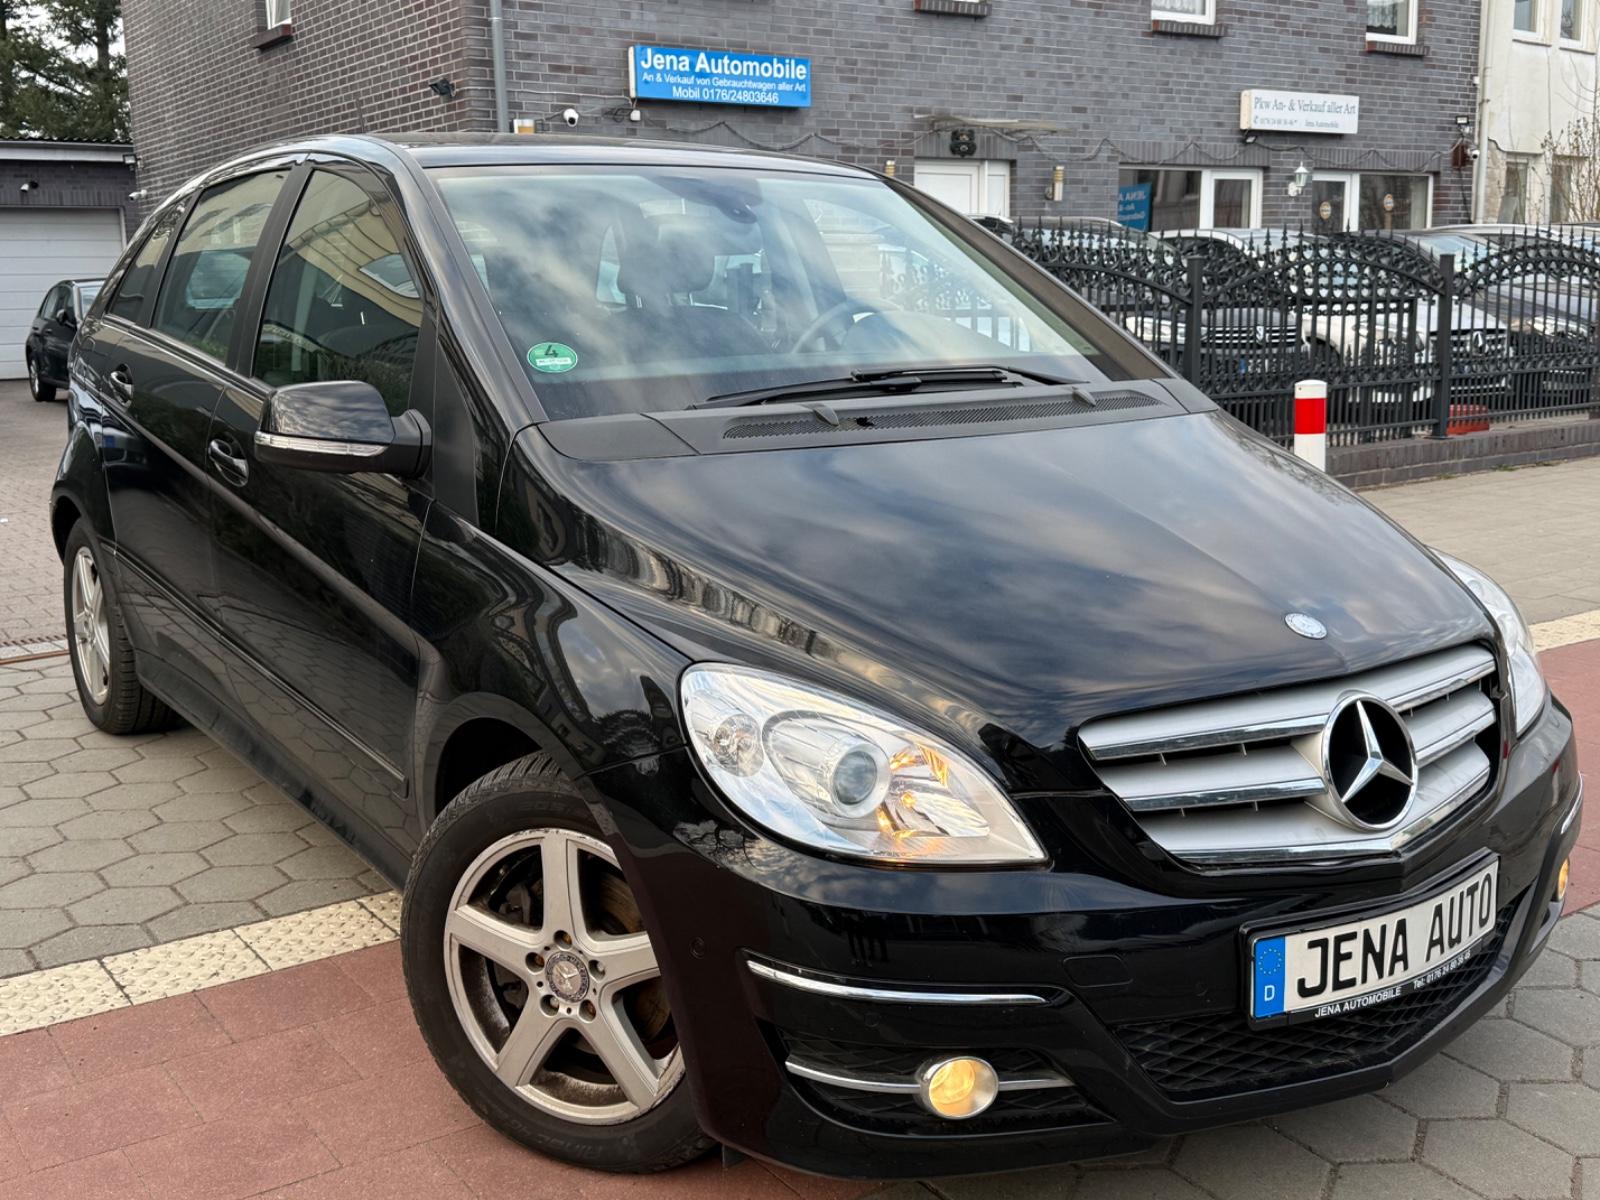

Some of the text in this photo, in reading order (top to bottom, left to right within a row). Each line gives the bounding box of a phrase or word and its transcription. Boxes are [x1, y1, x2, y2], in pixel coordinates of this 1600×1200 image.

[640, 48, 807, 80] Jena Automobile
[642, 72, 806, 92] An & Verkauf von Gebrauchtwagen aller Art
[672, 86, 700, 99] Mobil
[1254, 97, 1356, 114] Pkw An- & Verkauf aller Art
[544, 344, 559, 358] 4
[1296, 873, 1492, 998] JENA AUTO
[1264, 985, 1275, 1002] D
[1314, 986, 1402, 1018] JENA AUTOMOBILE
